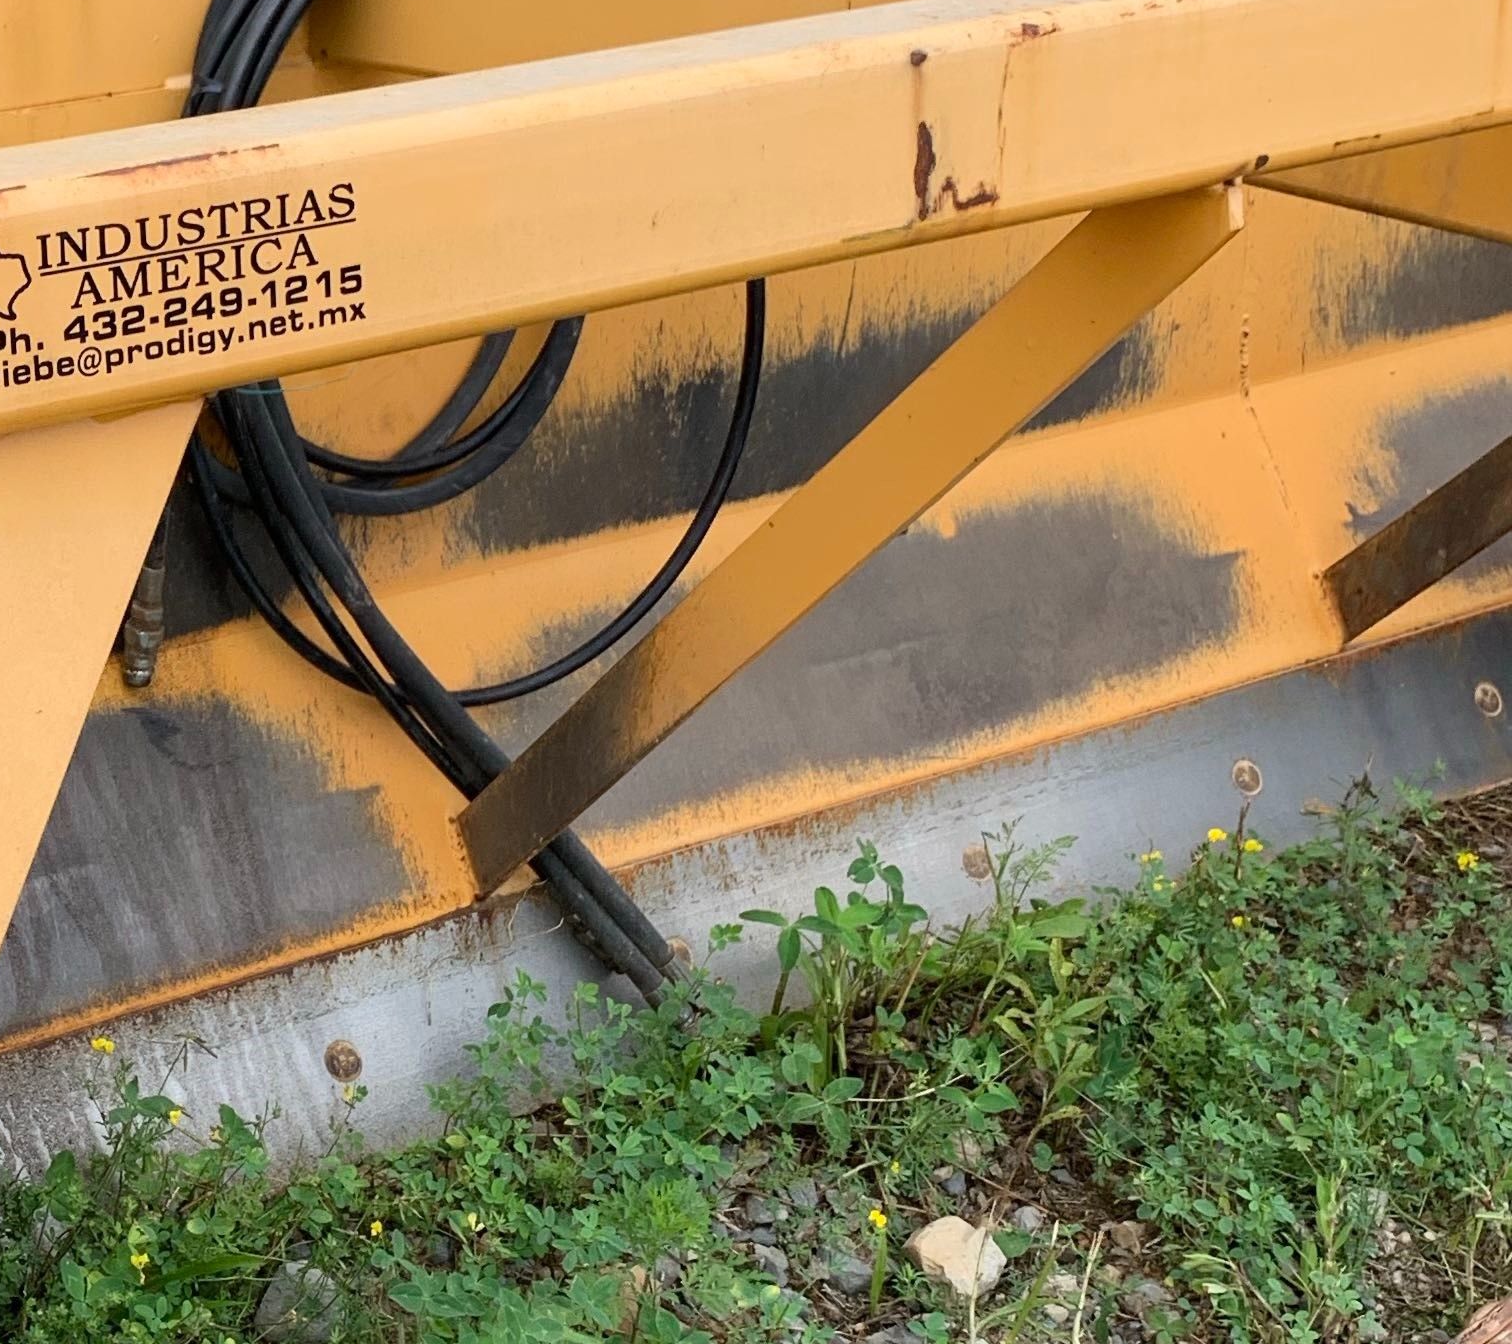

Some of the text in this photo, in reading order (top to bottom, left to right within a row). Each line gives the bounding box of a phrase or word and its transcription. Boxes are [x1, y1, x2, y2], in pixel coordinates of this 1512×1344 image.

[35, 182, 356, 270] INDUSTRIAS
[63, 264, 363, 345] 432-249-1215
[71, 233, 319, 310] AMERICA
